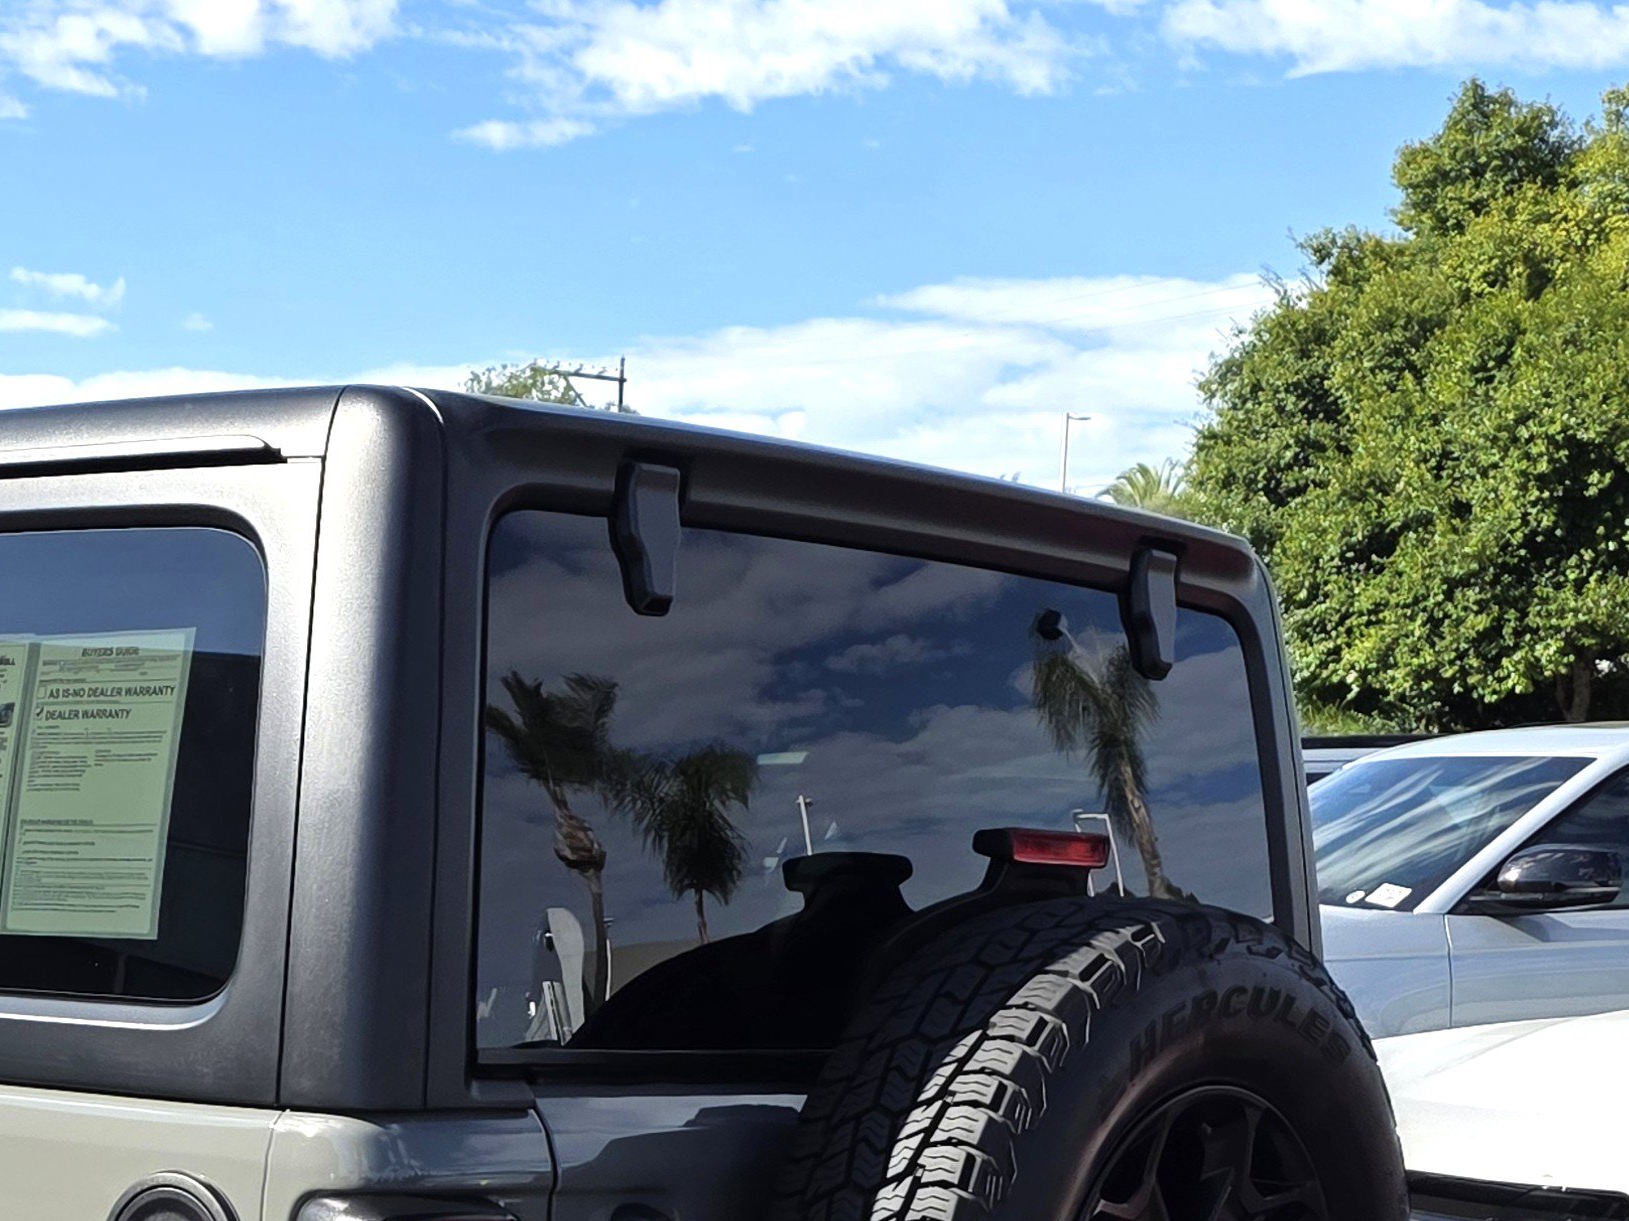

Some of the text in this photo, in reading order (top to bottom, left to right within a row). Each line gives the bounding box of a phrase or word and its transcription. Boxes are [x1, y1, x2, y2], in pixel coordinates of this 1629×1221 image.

[48, 688, 61, 699] AS
[86, 687, 122, 698] DEALER
[124, 685, 176, 697] WARRANTY
[45, 708, 132, 721] DEALER WARRANTY
[1127, 984, 1352, 1081] HERCULES
